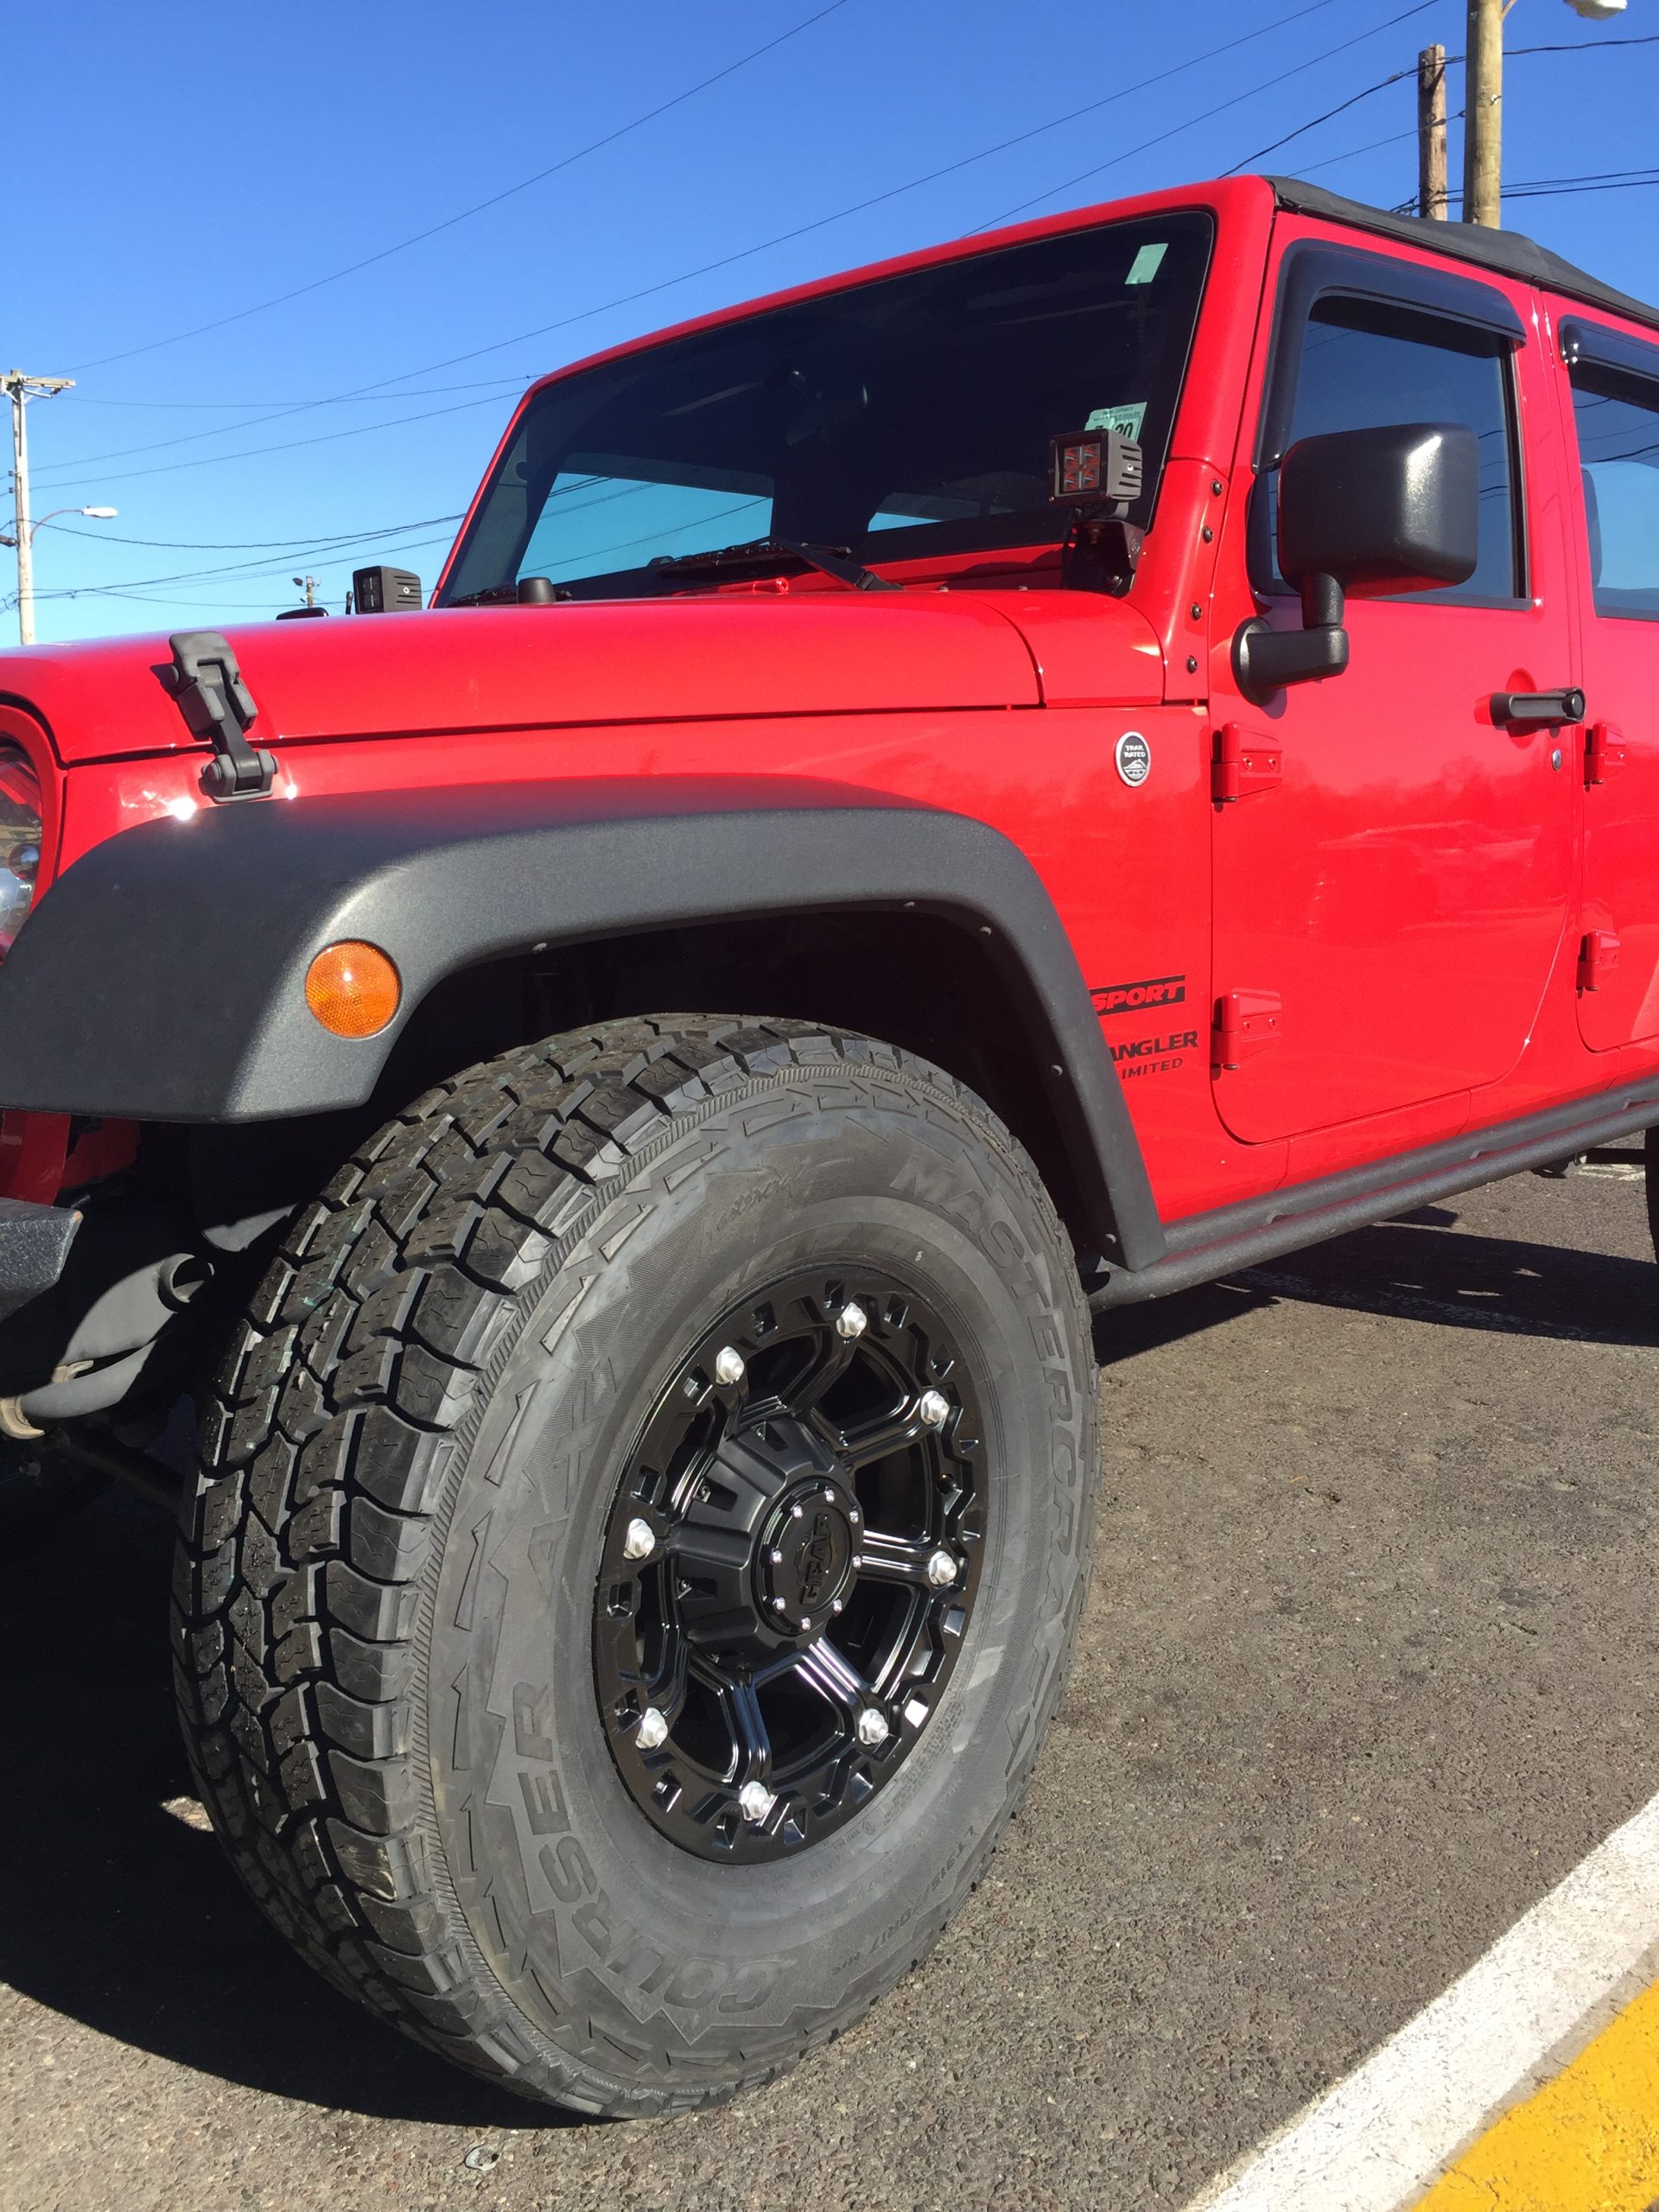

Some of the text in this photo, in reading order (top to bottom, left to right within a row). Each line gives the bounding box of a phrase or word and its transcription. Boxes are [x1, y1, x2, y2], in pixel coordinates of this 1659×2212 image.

[1092, 982, 1185, 1011] SPORT
[1122, 1057, 1183, 1080] IMITED
[512, 1681, 782, 2013] COURSER
